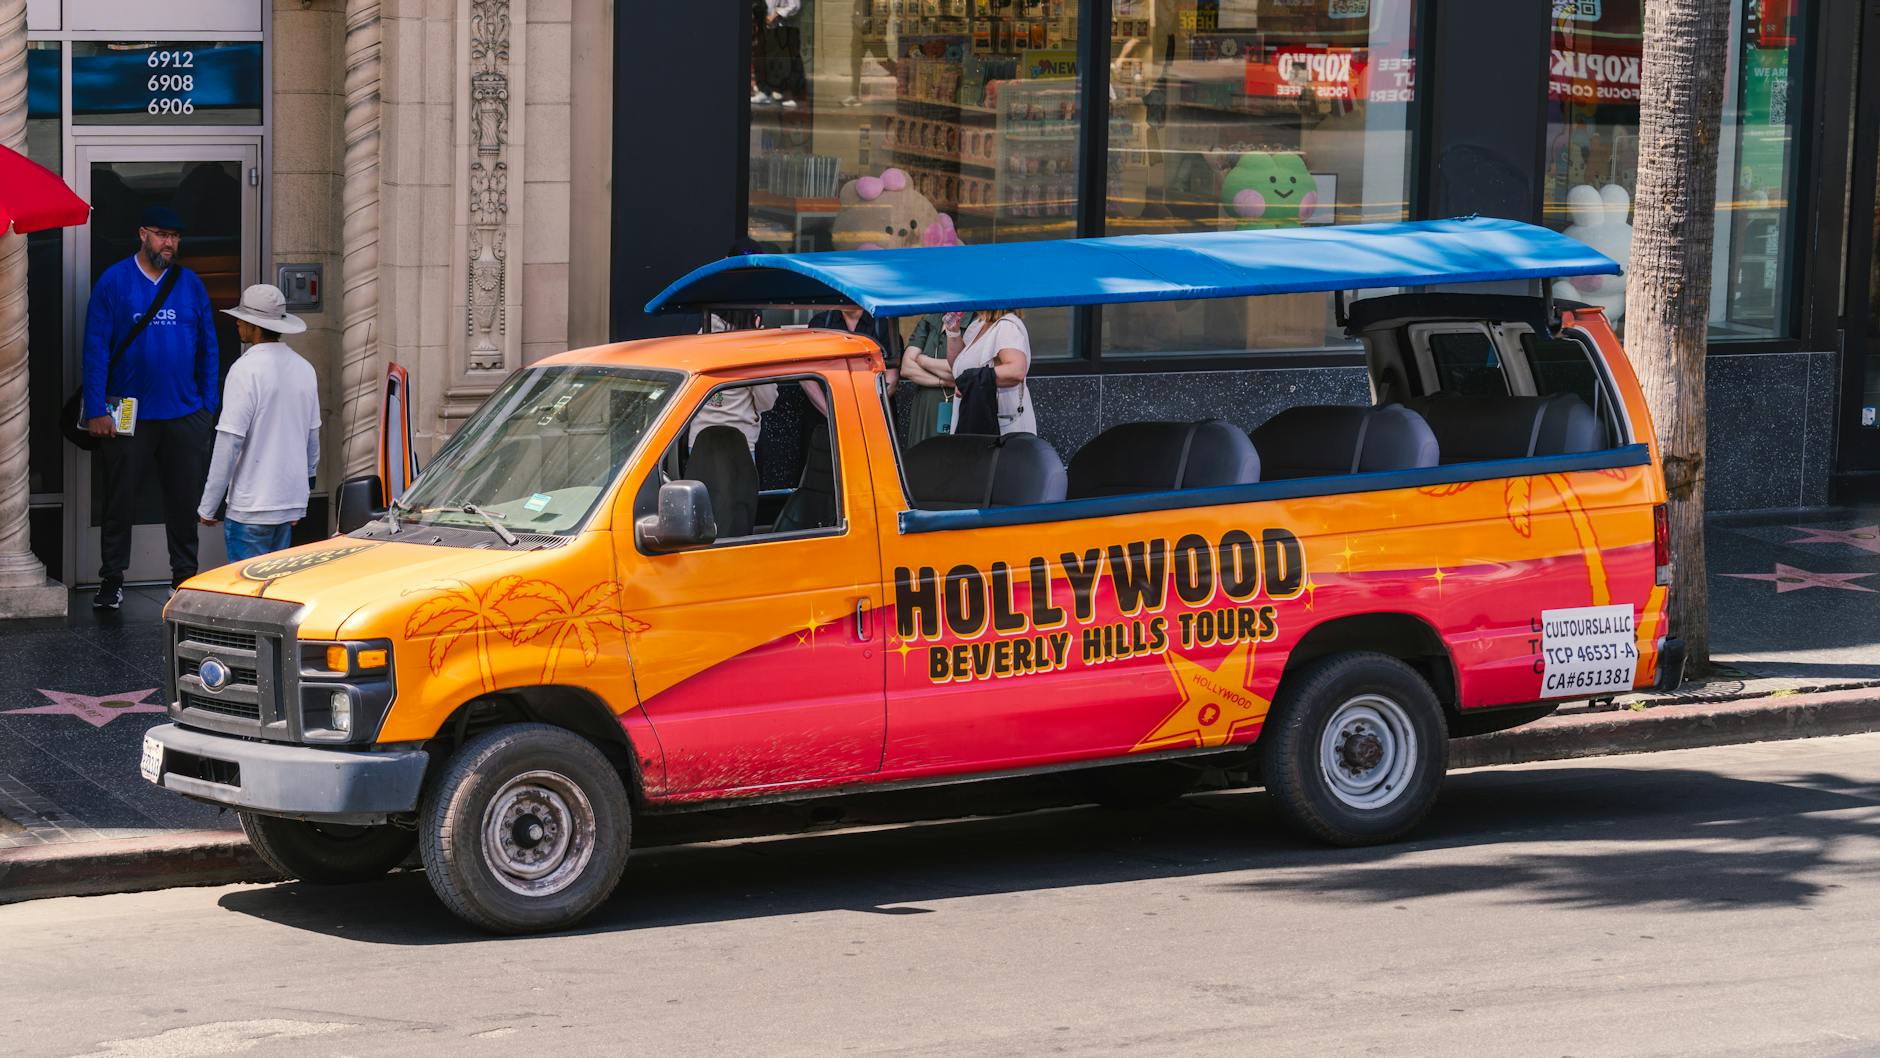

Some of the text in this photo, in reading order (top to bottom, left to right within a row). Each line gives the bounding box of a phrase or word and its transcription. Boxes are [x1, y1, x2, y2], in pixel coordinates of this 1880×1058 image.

[147, 51, 194, 68] 6912
[147, 75, 194, 92] 6908
[147, 98, 194, 115] 6906
[894, 528, 1307, 641] HOLLYWOOD
[1545, 617, 1612, 639] CULTOURSLA
[1613, 616, 1631, 633] LLC
[929, 605, 1279, 683] BEVERLY HILLS TOURS
[1546, 647, 1573, 665] TCP
[1546, 667, 1630, 690] CA#651381
[1193, 674, 1252, 709] HOLLYWOOD
